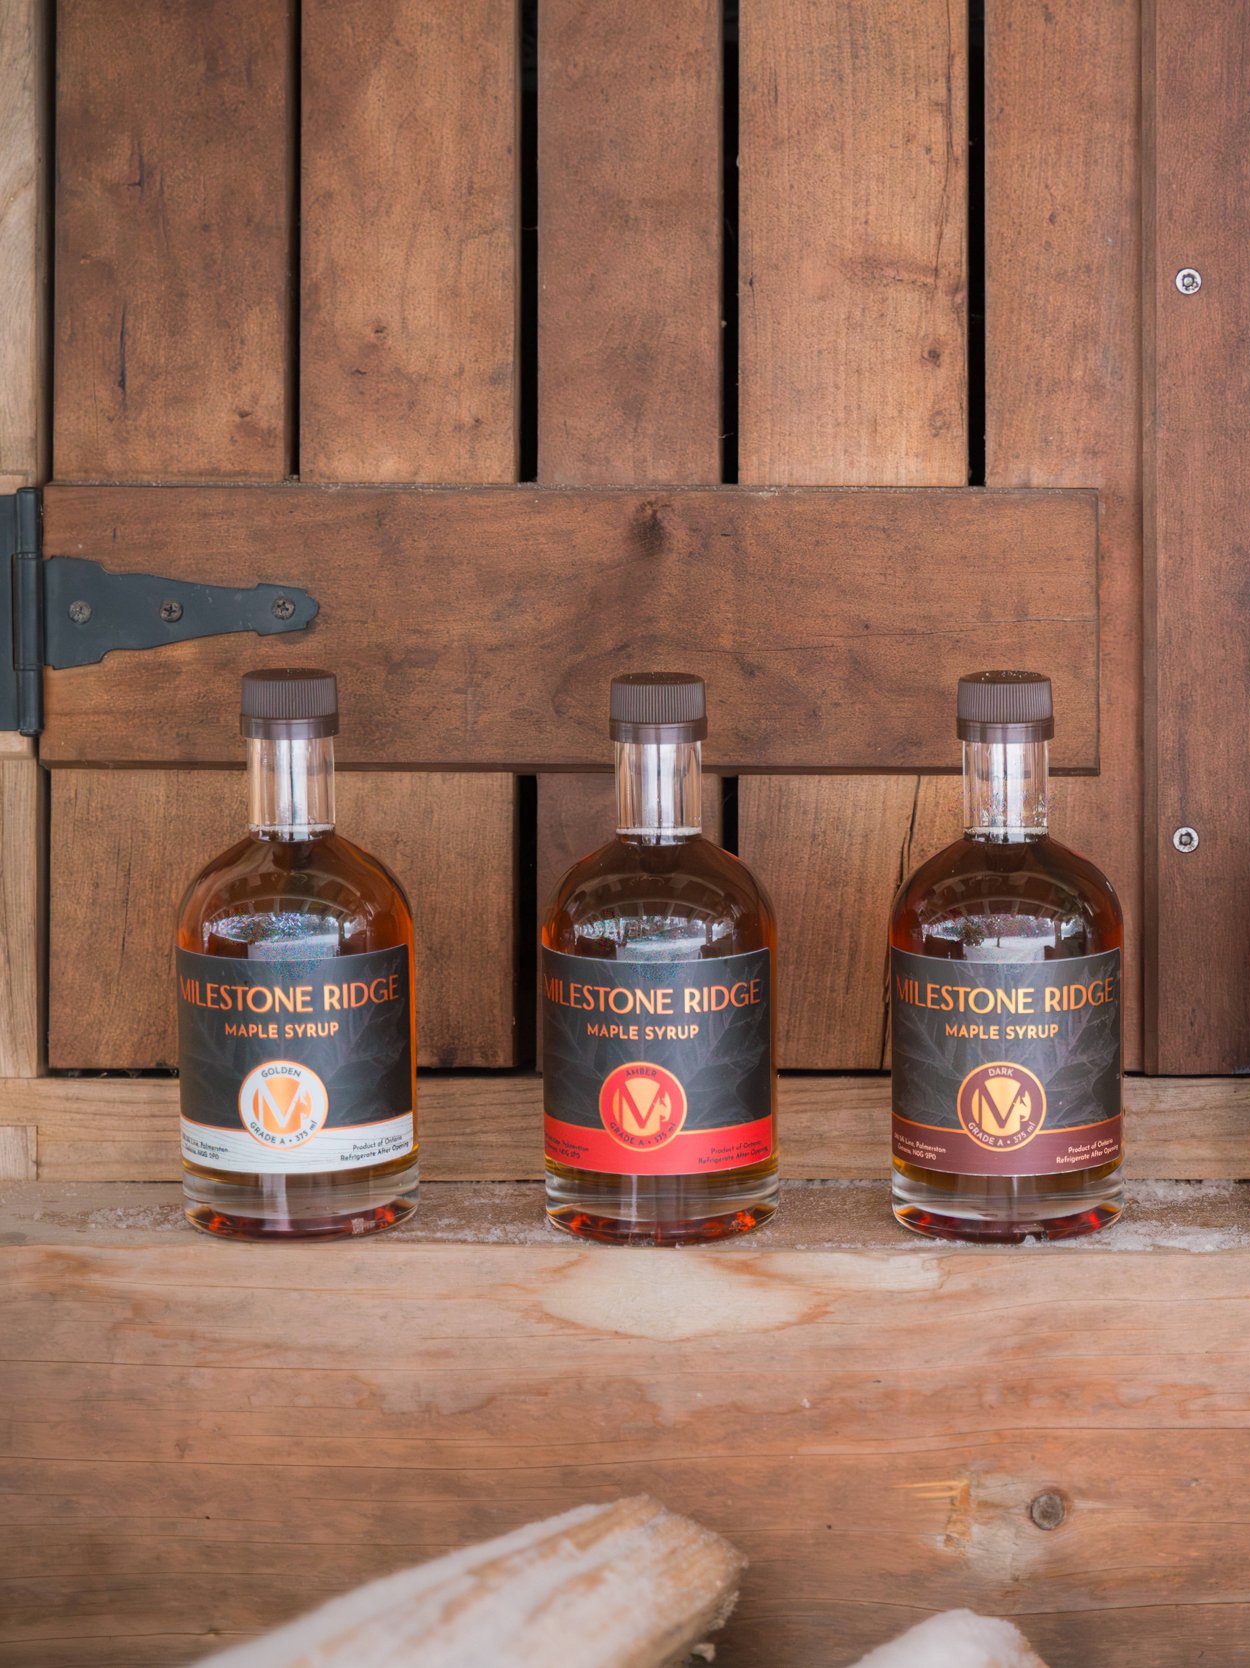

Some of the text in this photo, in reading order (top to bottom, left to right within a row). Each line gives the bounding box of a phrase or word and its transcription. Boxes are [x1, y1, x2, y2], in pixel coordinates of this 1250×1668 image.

[180, 974, 399, 1013] MILESTONE RIDGE
[544, 973, 761, 1015] MILESTONE RIDGE
[896, 975, 1114, 1014] MILESTONE RIDGE
[225, 1022, 339, 1039] MAPLE SYRUP
[587, 1023, 699, 1040] MAPLE SYRUP
[945, 1023, 1059, 1040] MAPLE SYRUP
[261, 1066, 301, 1078] GOLDEN
[625, 1067, 657, 1077] AMBER
[988, 1068, 1014, 1077] DARK
[249, 1121, 276, 1144] GRADE
[295, 1130, 309, 1143] 375
[309, 1119, 318, 1132] ml
[609, 1121, 635, 1145] GRADE
[638, 1138, 644, 1146] A
[968, 1121, 1036, 1147] GRADE A 375 ml
[353, 1142, 376, 1151] Product
[915, 1141, 946, 1154] Palmerston
[1068, 1144, 1090, 1154] Product
[1091, 1140, 1097, 1149] of
[340, 1151, 376, 1161] Refrigerate
[1056, 1154, 1090, 1164] Refrigerate
[1091, 1149, 1103, 1158] After
